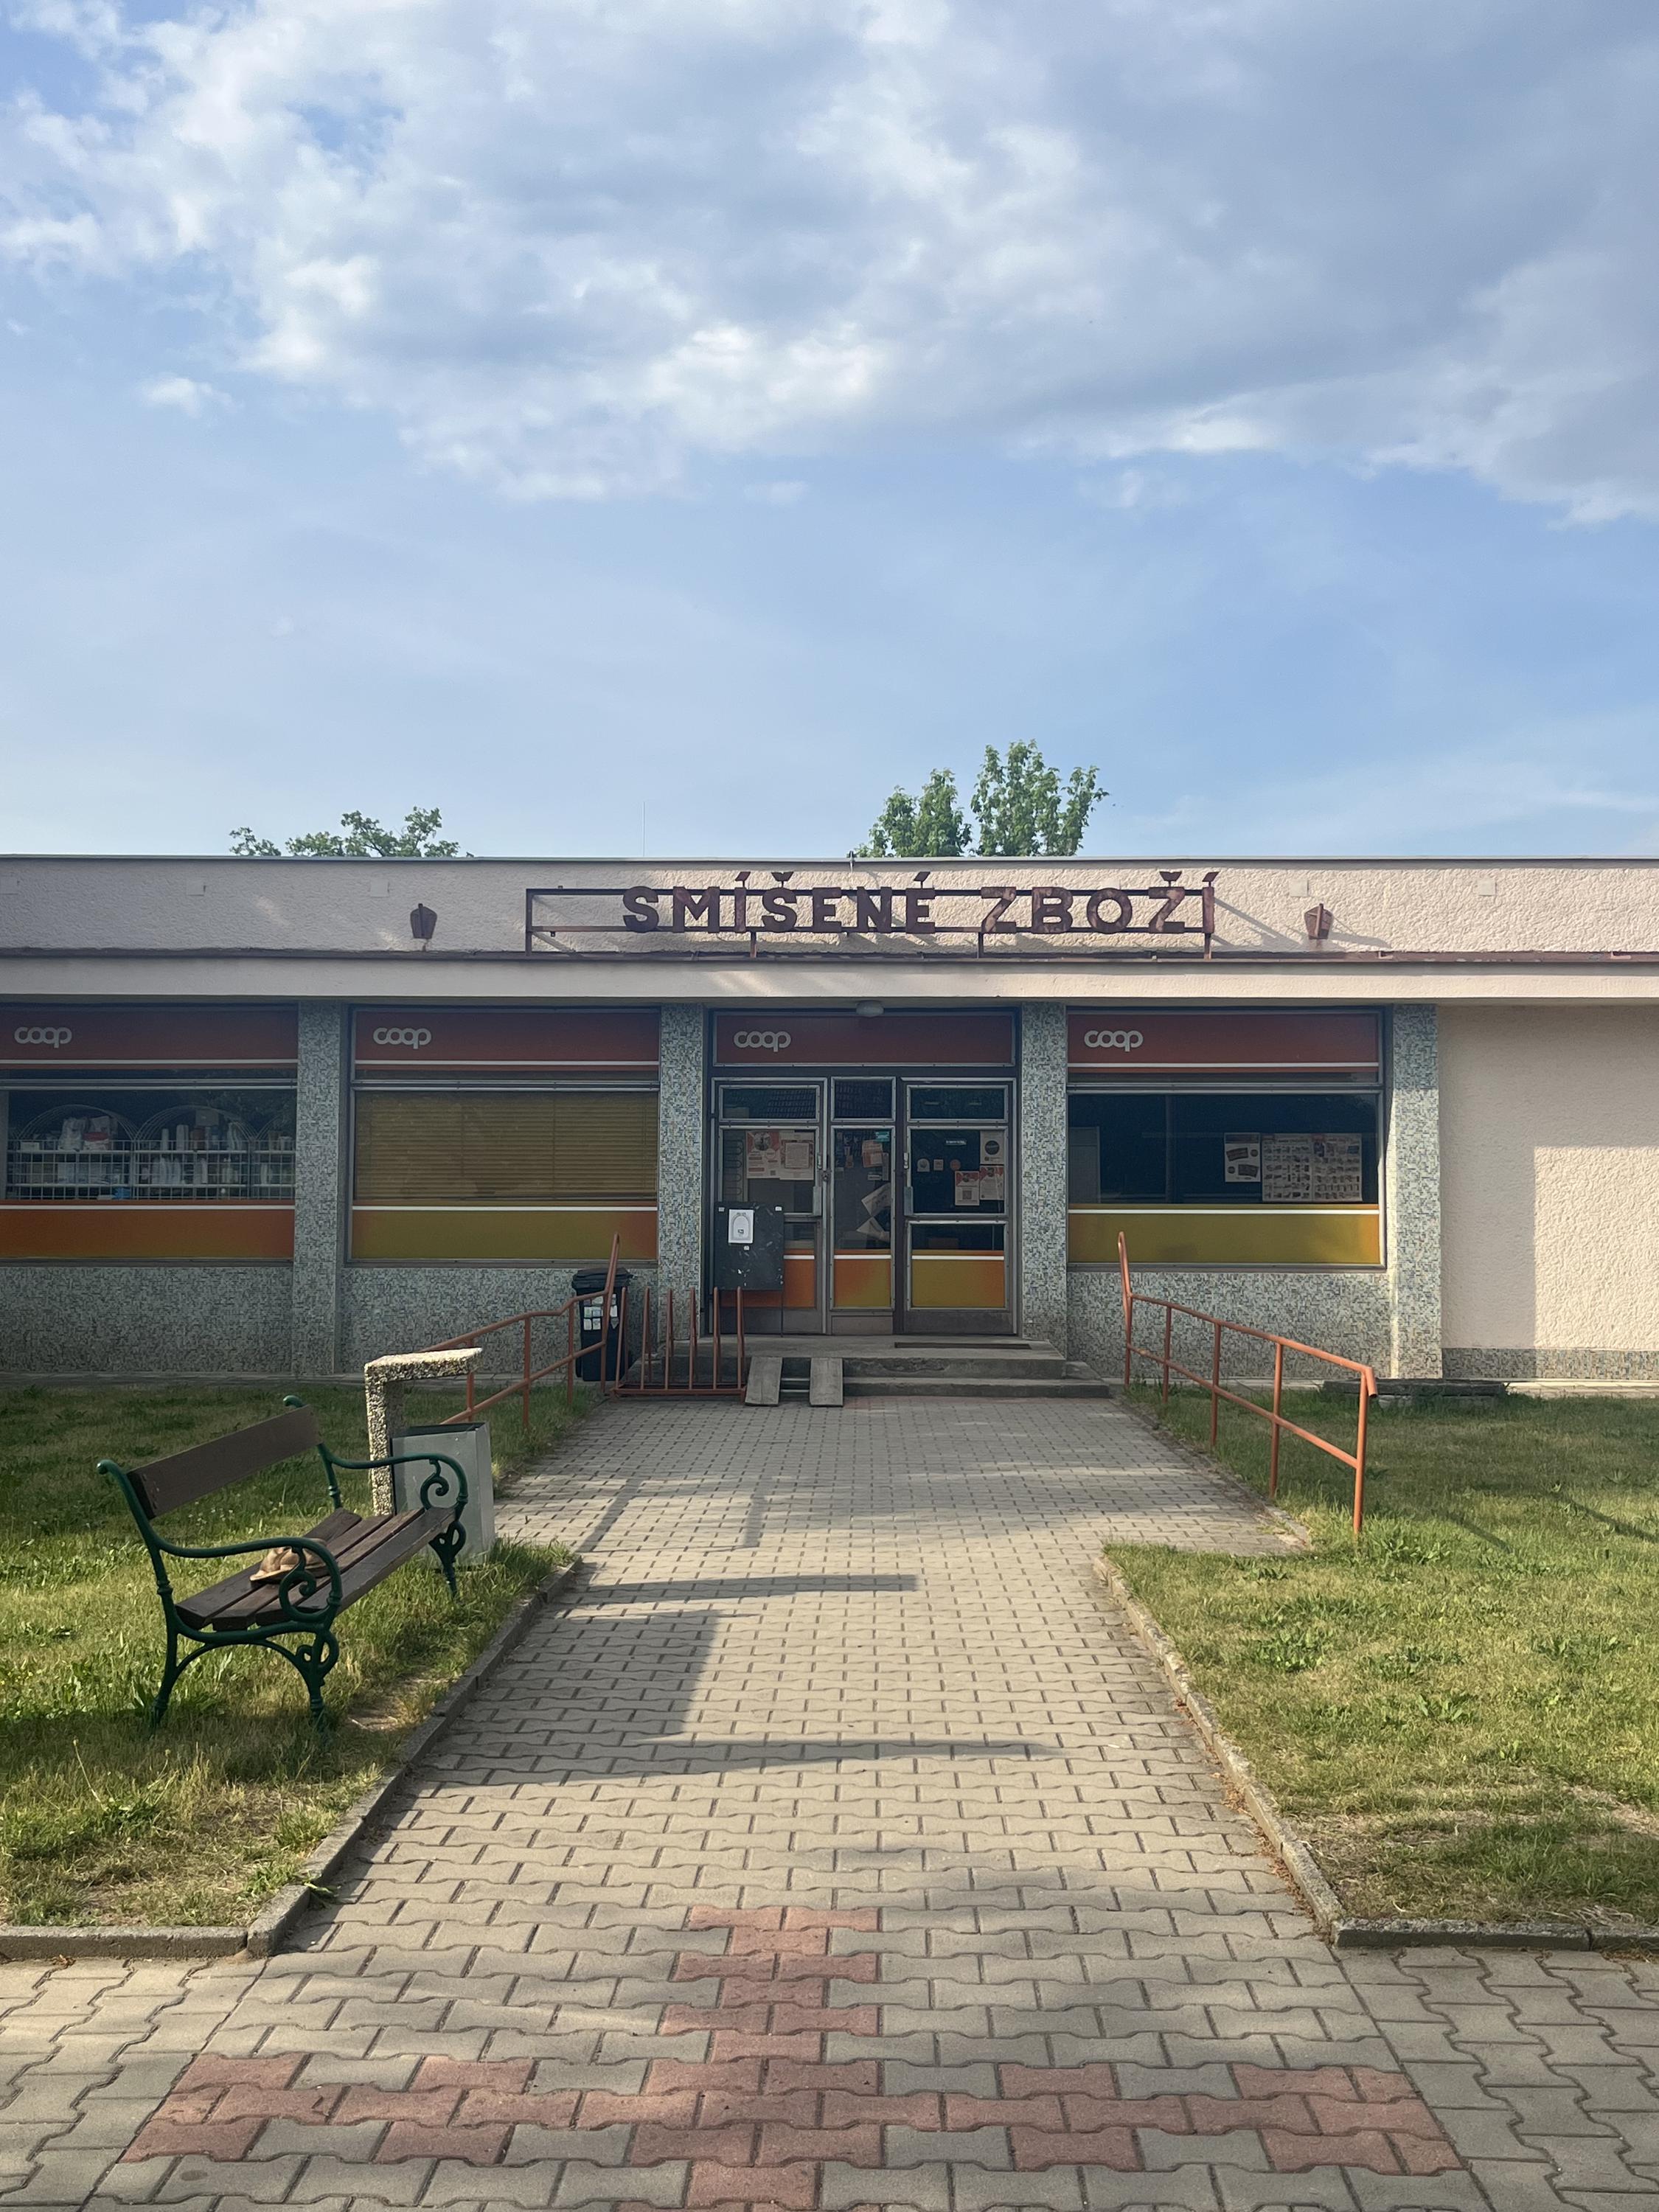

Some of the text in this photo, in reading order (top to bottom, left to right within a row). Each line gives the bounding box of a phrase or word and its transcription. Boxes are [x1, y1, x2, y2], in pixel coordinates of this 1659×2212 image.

[622, 871, 1220, 934] SMÍŠENÉ ZBOŽÍ
[14, 1026, 72, 1048] coop
[373, 1027, 432, 1049] coop
[733, 1031, 791, 1052] coop
[1084, 1029, 1144, 1052] coop
